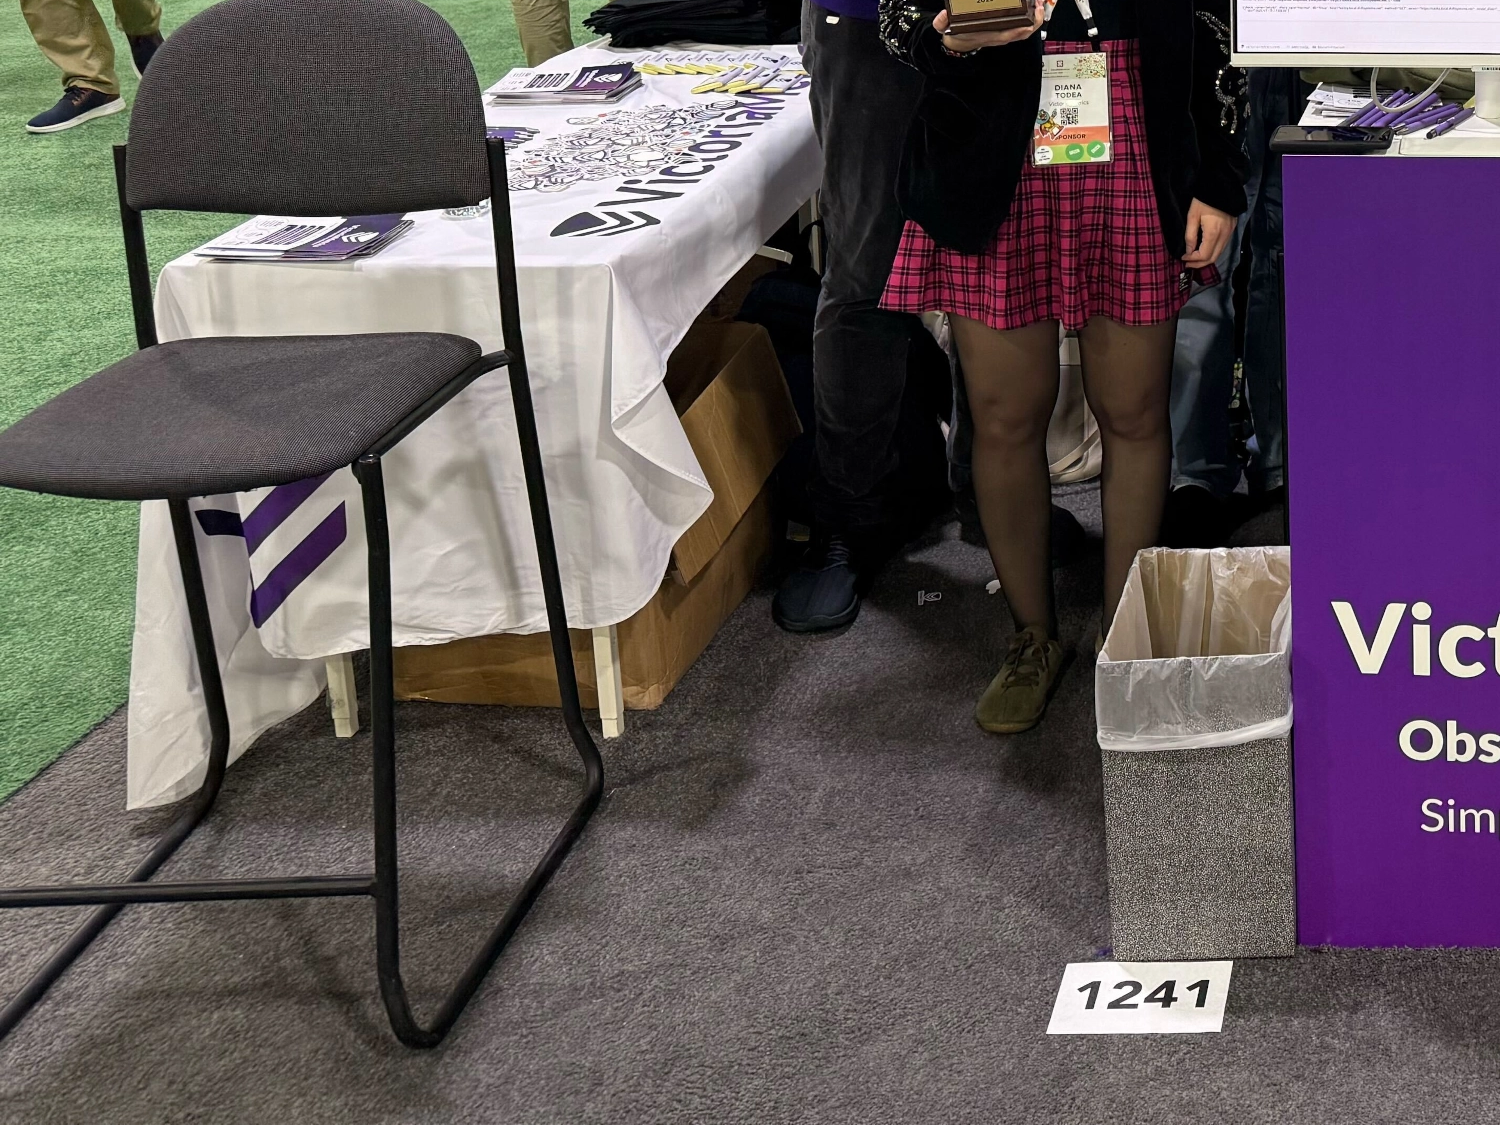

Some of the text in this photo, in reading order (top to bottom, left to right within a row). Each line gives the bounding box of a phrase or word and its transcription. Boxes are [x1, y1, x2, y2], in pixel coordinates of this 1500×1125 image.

[1054, 83, 1082, 91] DIANA
[1055, 91, 1082, 99] TODEA
[1074, 975, 1213, 1012] 1241
